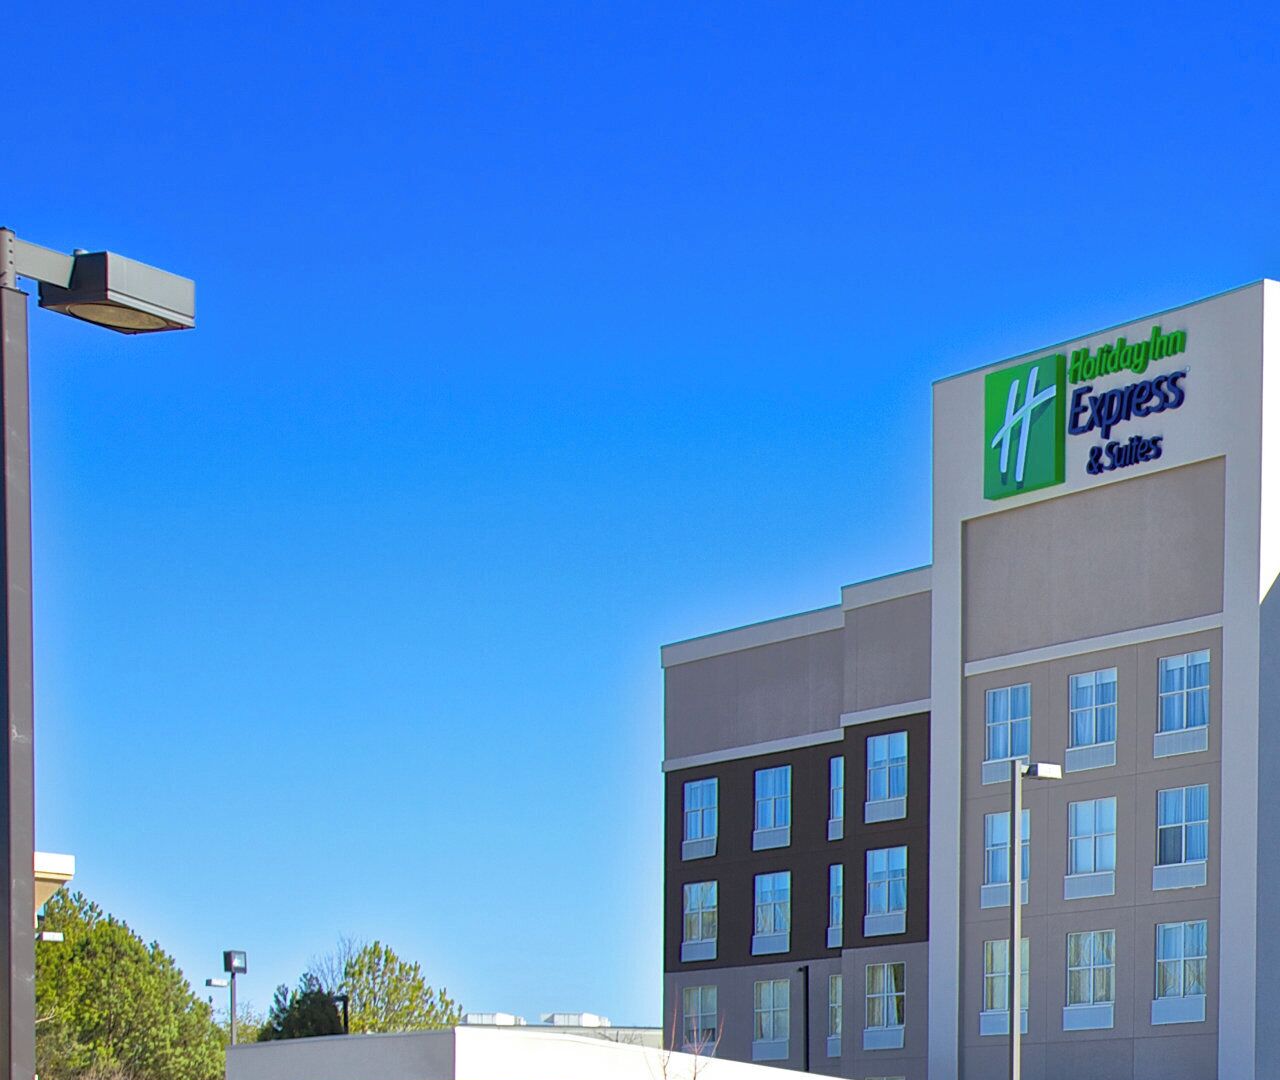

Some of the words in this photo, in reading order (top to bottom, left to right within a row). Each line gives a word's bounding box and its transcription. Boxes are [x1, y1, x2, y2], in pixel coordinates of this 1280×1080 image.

[1069, 337, 1150, 384] Holiday
[1149, 325, 1187, 361] Inn
[1068, 371, 1187, 439] Express
[1086, 446, 1104, 475] &
[1102, 435, 1163, 471] Suites
